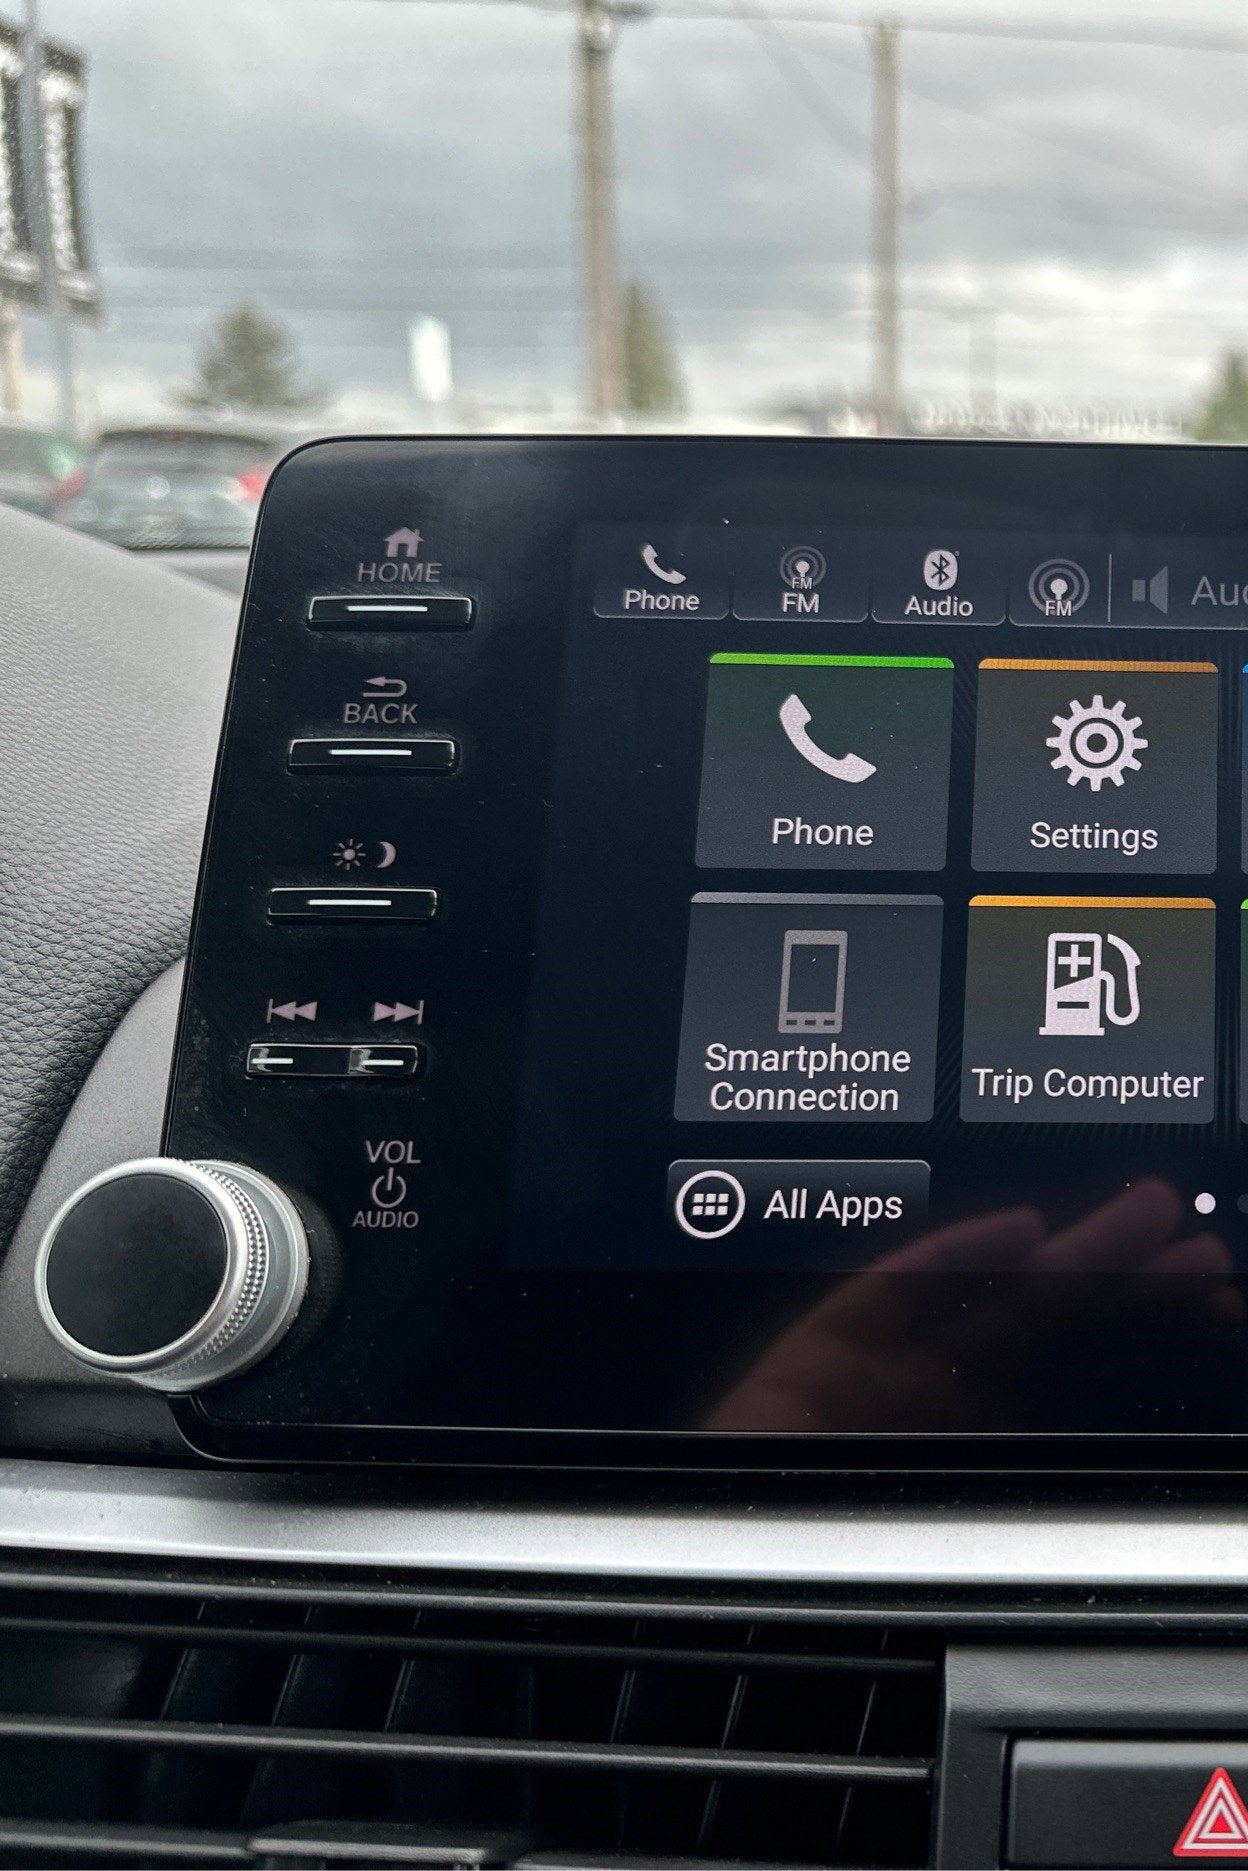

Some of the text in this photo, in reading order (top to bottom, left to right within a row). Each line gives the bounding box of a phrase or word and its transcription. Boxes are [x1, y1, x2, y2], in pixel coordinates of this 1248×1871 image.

[357, 561, 443, 583] HOME
[624, 589, 701, 612] Phone
[782, 592, 820, 613] FM
[904, 594, 974, 618] Audio
[1044, 601, 1072, 617] FM
[344, 703, 418, 724] BACK
[772, 817, 875, 848] Phone
[1029, 821, 1160, 856] Settings
[704, 1042, 912, 1079] Smartphone
[709, 1082, 900, 1112] Connection
[971, 1068, 1206, 1104] Trip Computer
[365, 1140, 422, 1164] VOL
[352, 1210, 420, 1229] AUDIO
[763, 1189, 904, 1227] All Apps
